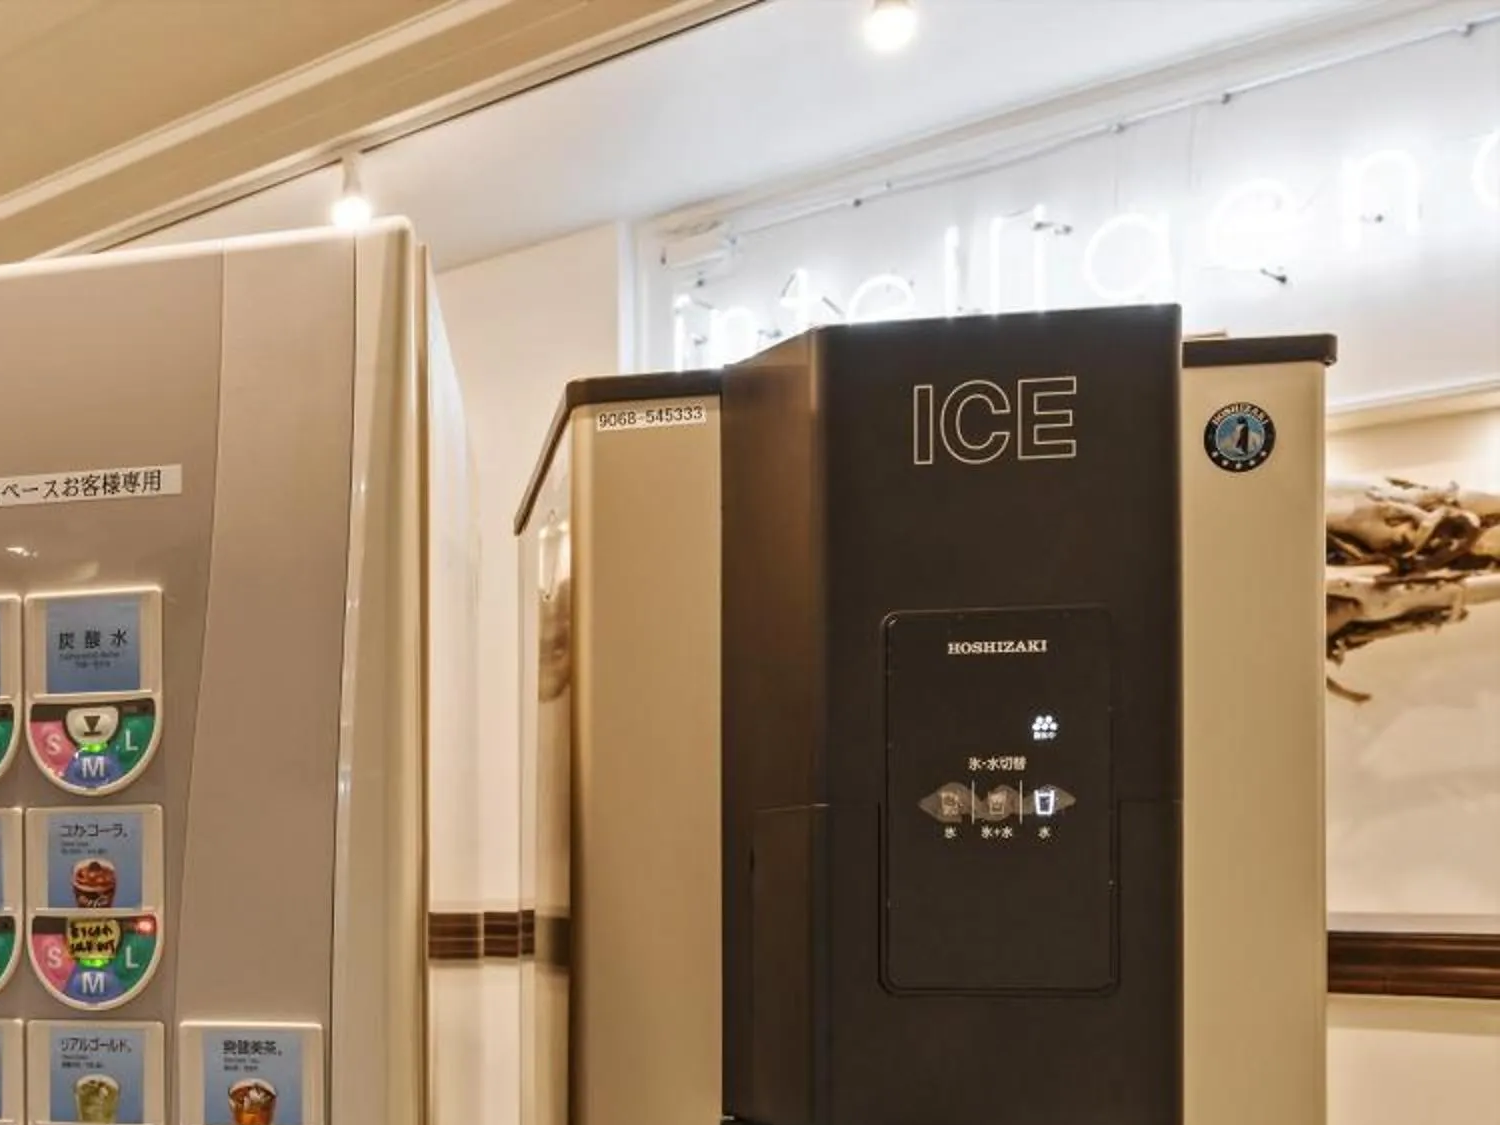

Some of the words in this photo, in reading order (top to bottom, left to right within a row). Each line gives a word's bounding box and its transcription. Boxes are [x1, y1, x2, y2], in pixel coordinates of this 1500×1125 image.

[913, 376, 1077, 466] ICE
[947, 639, 1048, 655] HOSHIZAKI
[46, 734, 62, 755] S
[125, 729, 139, 751] L
[81, 756, 105, 778] M
[47, 946, 62, 968] S
[125, 946, 139, 968] L
[81, 970, 105, 993] M
